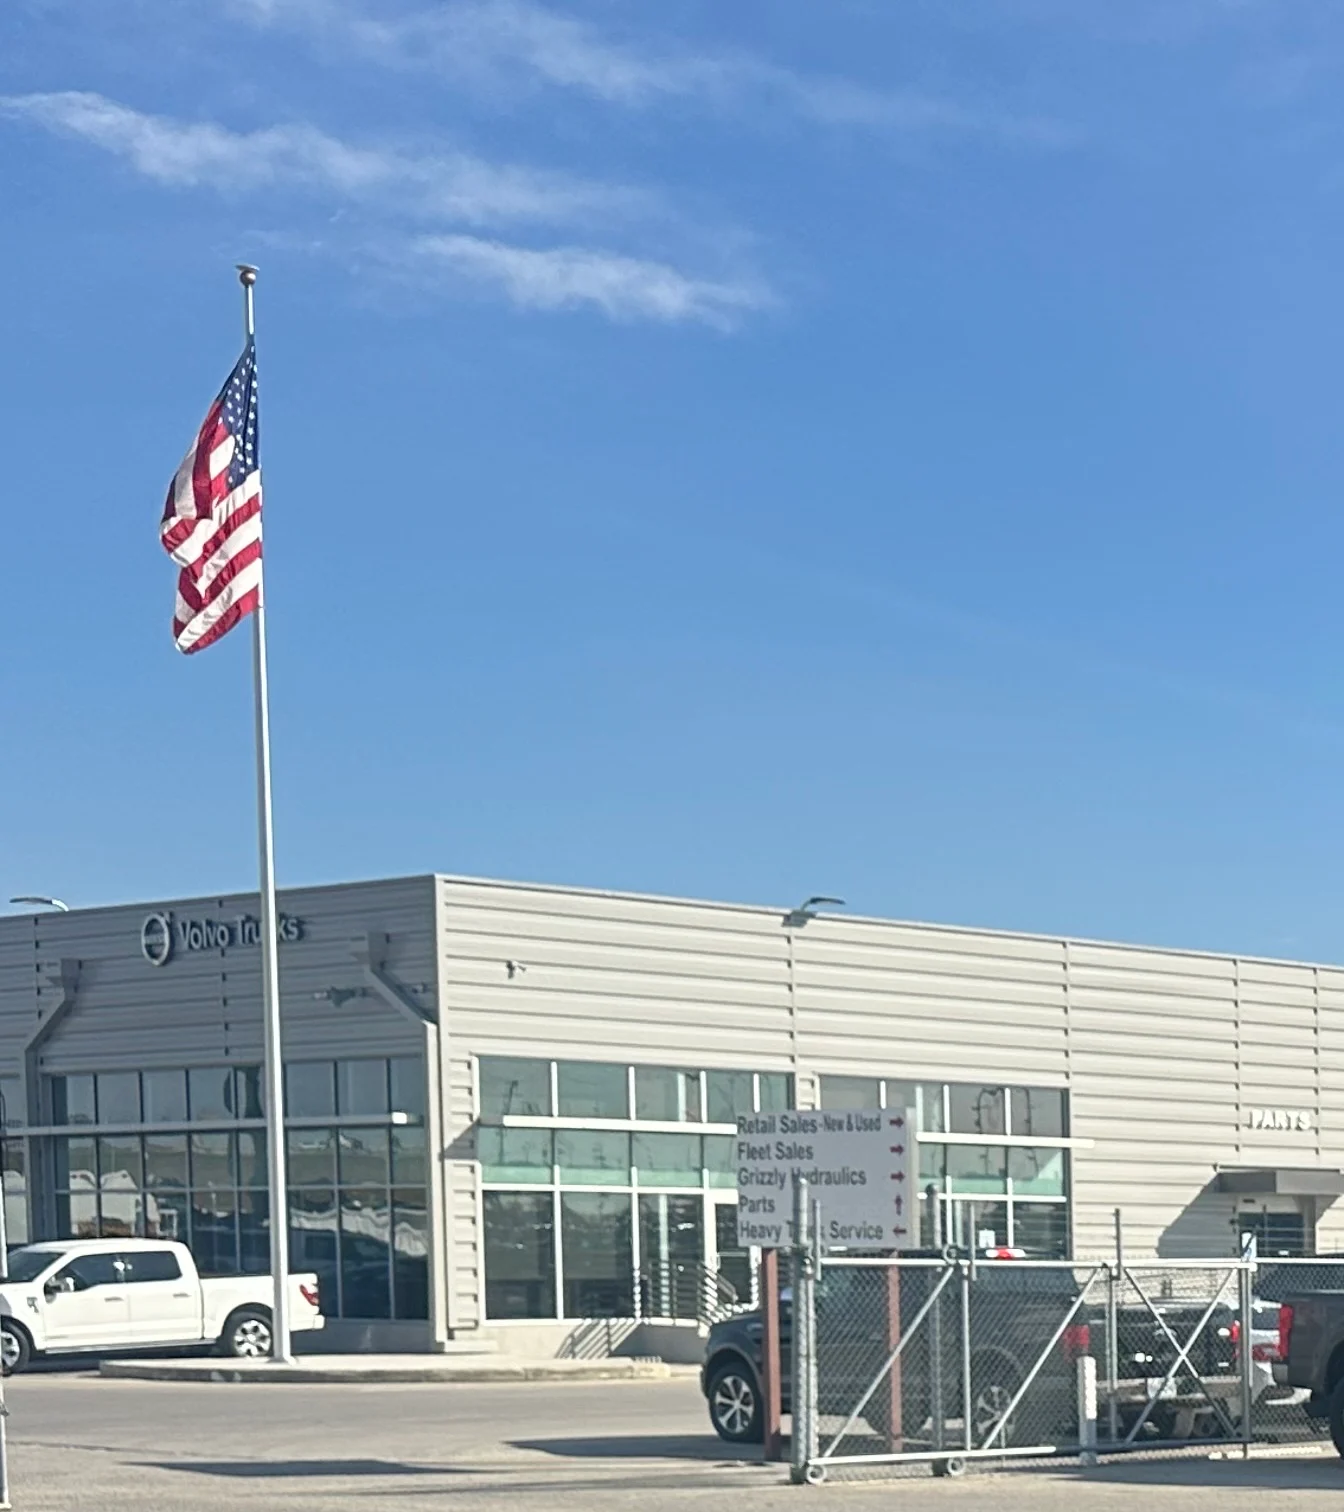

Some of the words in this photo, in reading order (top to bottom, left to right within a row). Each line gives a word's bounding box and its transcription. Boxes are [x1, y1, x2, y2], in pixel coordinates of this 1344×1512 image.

[179, 918, 229, 948] Volvo
[236, 914, 299, 945] Truks
[737, 1115, 776, 1134] Retail
[846, 1113, 853, 1132] &
[855, 1113, 882, 1132] Used
[1250, 1109, 1311, 1130] PARTS
[737, 1141, 771, 1160] Fleet
[775, 1140, 814, 1160] Sales
[737, 1167, 786, 1190] Grizzly
[739, 1195, 776, 1213] Parts
[740, 1221, 782, 1243] Heavy
[829, 1220, 884, 1240] Service
